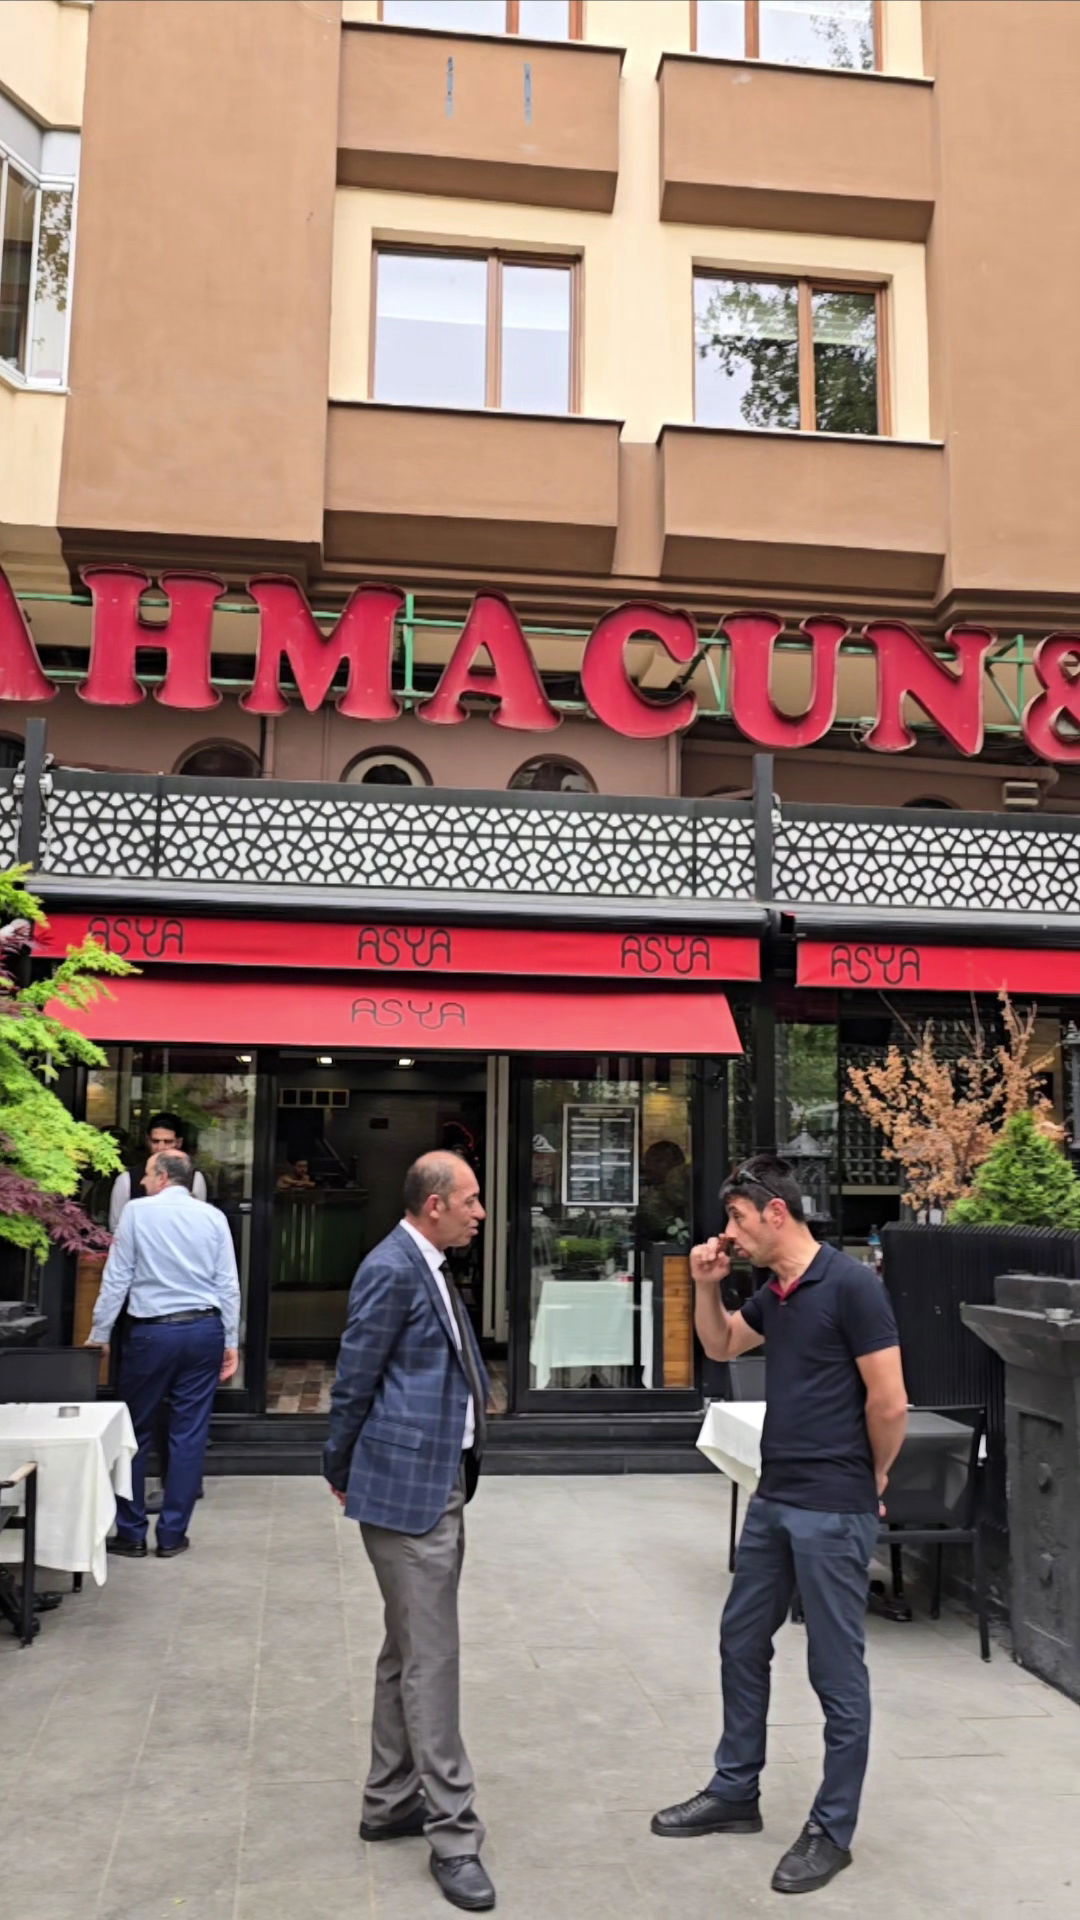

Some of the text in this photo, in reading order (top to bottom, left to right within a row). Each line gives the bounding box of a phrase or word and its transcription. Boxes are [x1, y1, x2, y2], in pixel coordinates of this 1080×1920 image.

[88, 917, 183, 957] ASYA
[358, 927, 451, 967] ASYA
[621, 935, 710, 973] ASYA
[831, 945, 920, 985] ASYA
[351, 998, 466, 1030] ASYA
